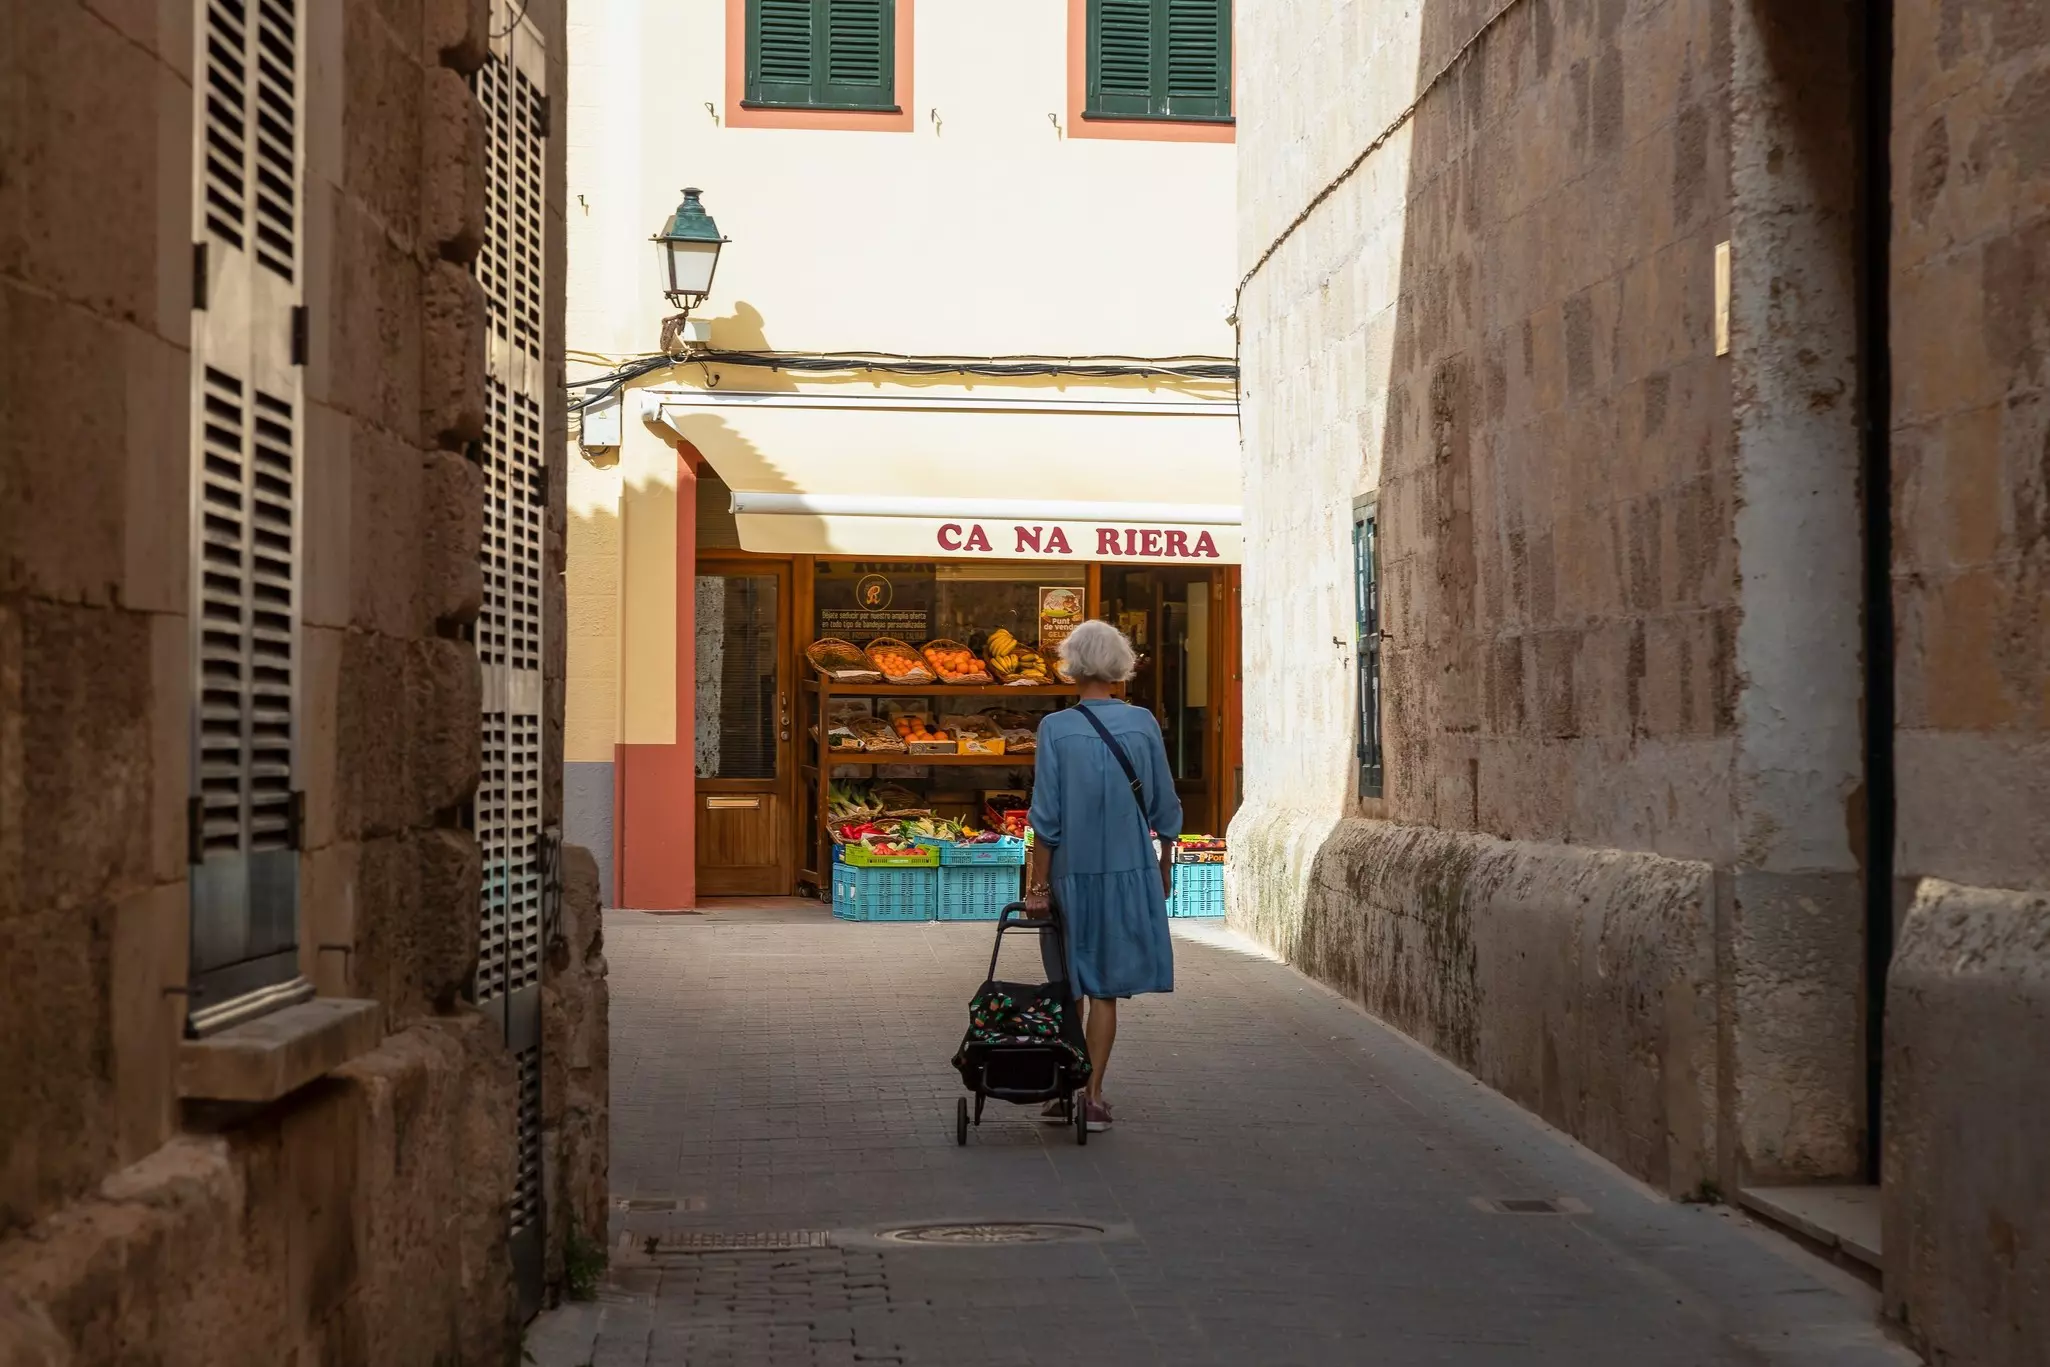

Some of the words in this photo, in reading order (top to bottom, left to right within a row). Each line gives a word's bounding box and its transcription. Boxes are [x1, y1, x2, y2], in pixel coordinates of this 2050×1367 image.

[937, 523, 993, 551] CA
[1014, 526, 1072, 553] NA
[1096, 528, 1220, 557] RIERA
